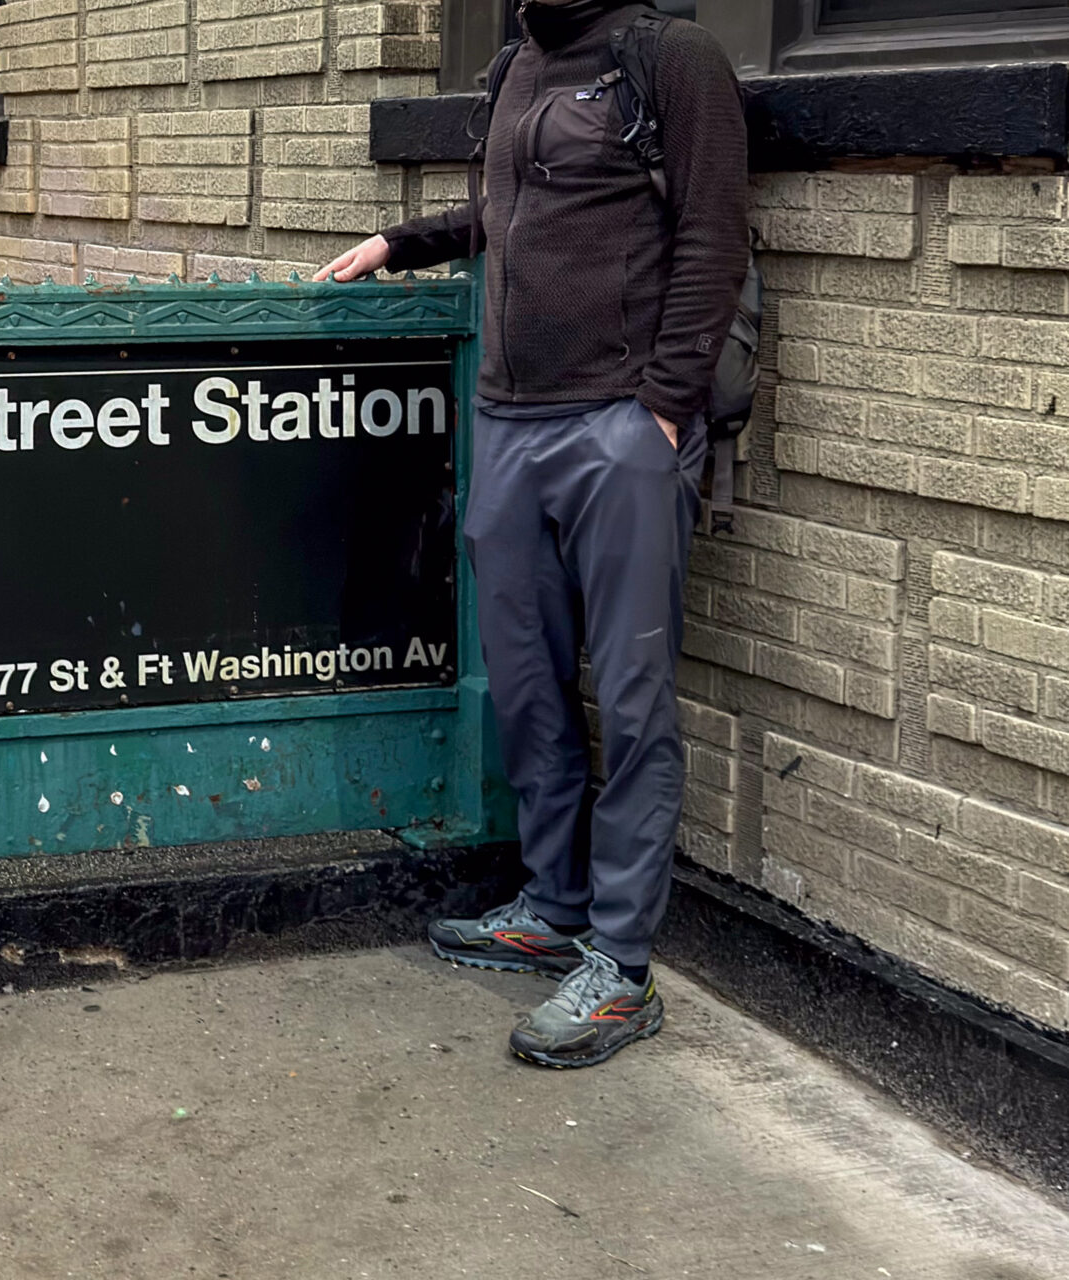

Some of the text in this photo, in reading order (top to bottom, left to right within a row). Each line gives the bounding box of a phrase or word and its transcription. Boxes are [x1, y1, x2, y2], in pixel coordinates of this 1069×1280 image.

[192, 373, 446, 443] Station
[49, 659, 89, 692] St
[99, 656, 127, 689] &
[138, 653, 174, 686] Ft
[182, 643, 394, 683] Washington
[402, 636, 447, 668] Av
